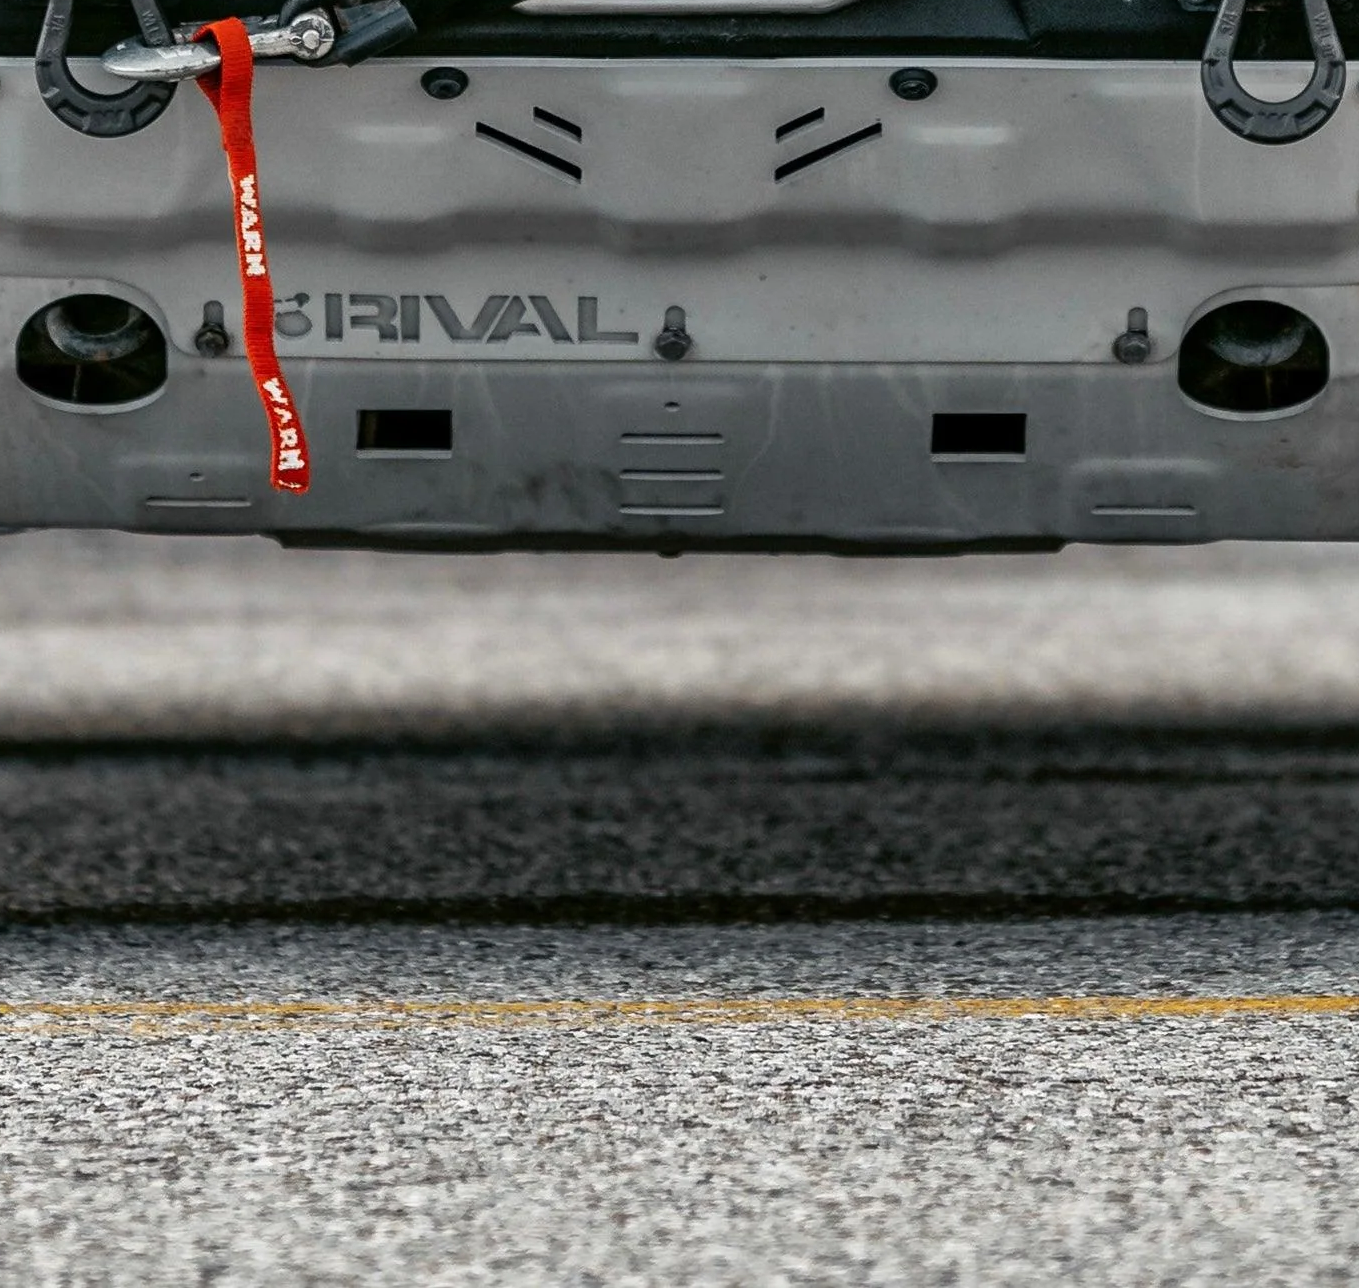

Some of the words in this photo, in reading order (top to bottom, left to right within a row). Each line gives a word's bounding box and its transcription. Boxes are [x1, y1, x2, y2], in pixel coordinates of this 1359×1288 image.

[240, 174, 266, 277] WARN
[324, 293, 640, 344] RIVAL
[262, 377, 306, 472] WARN
